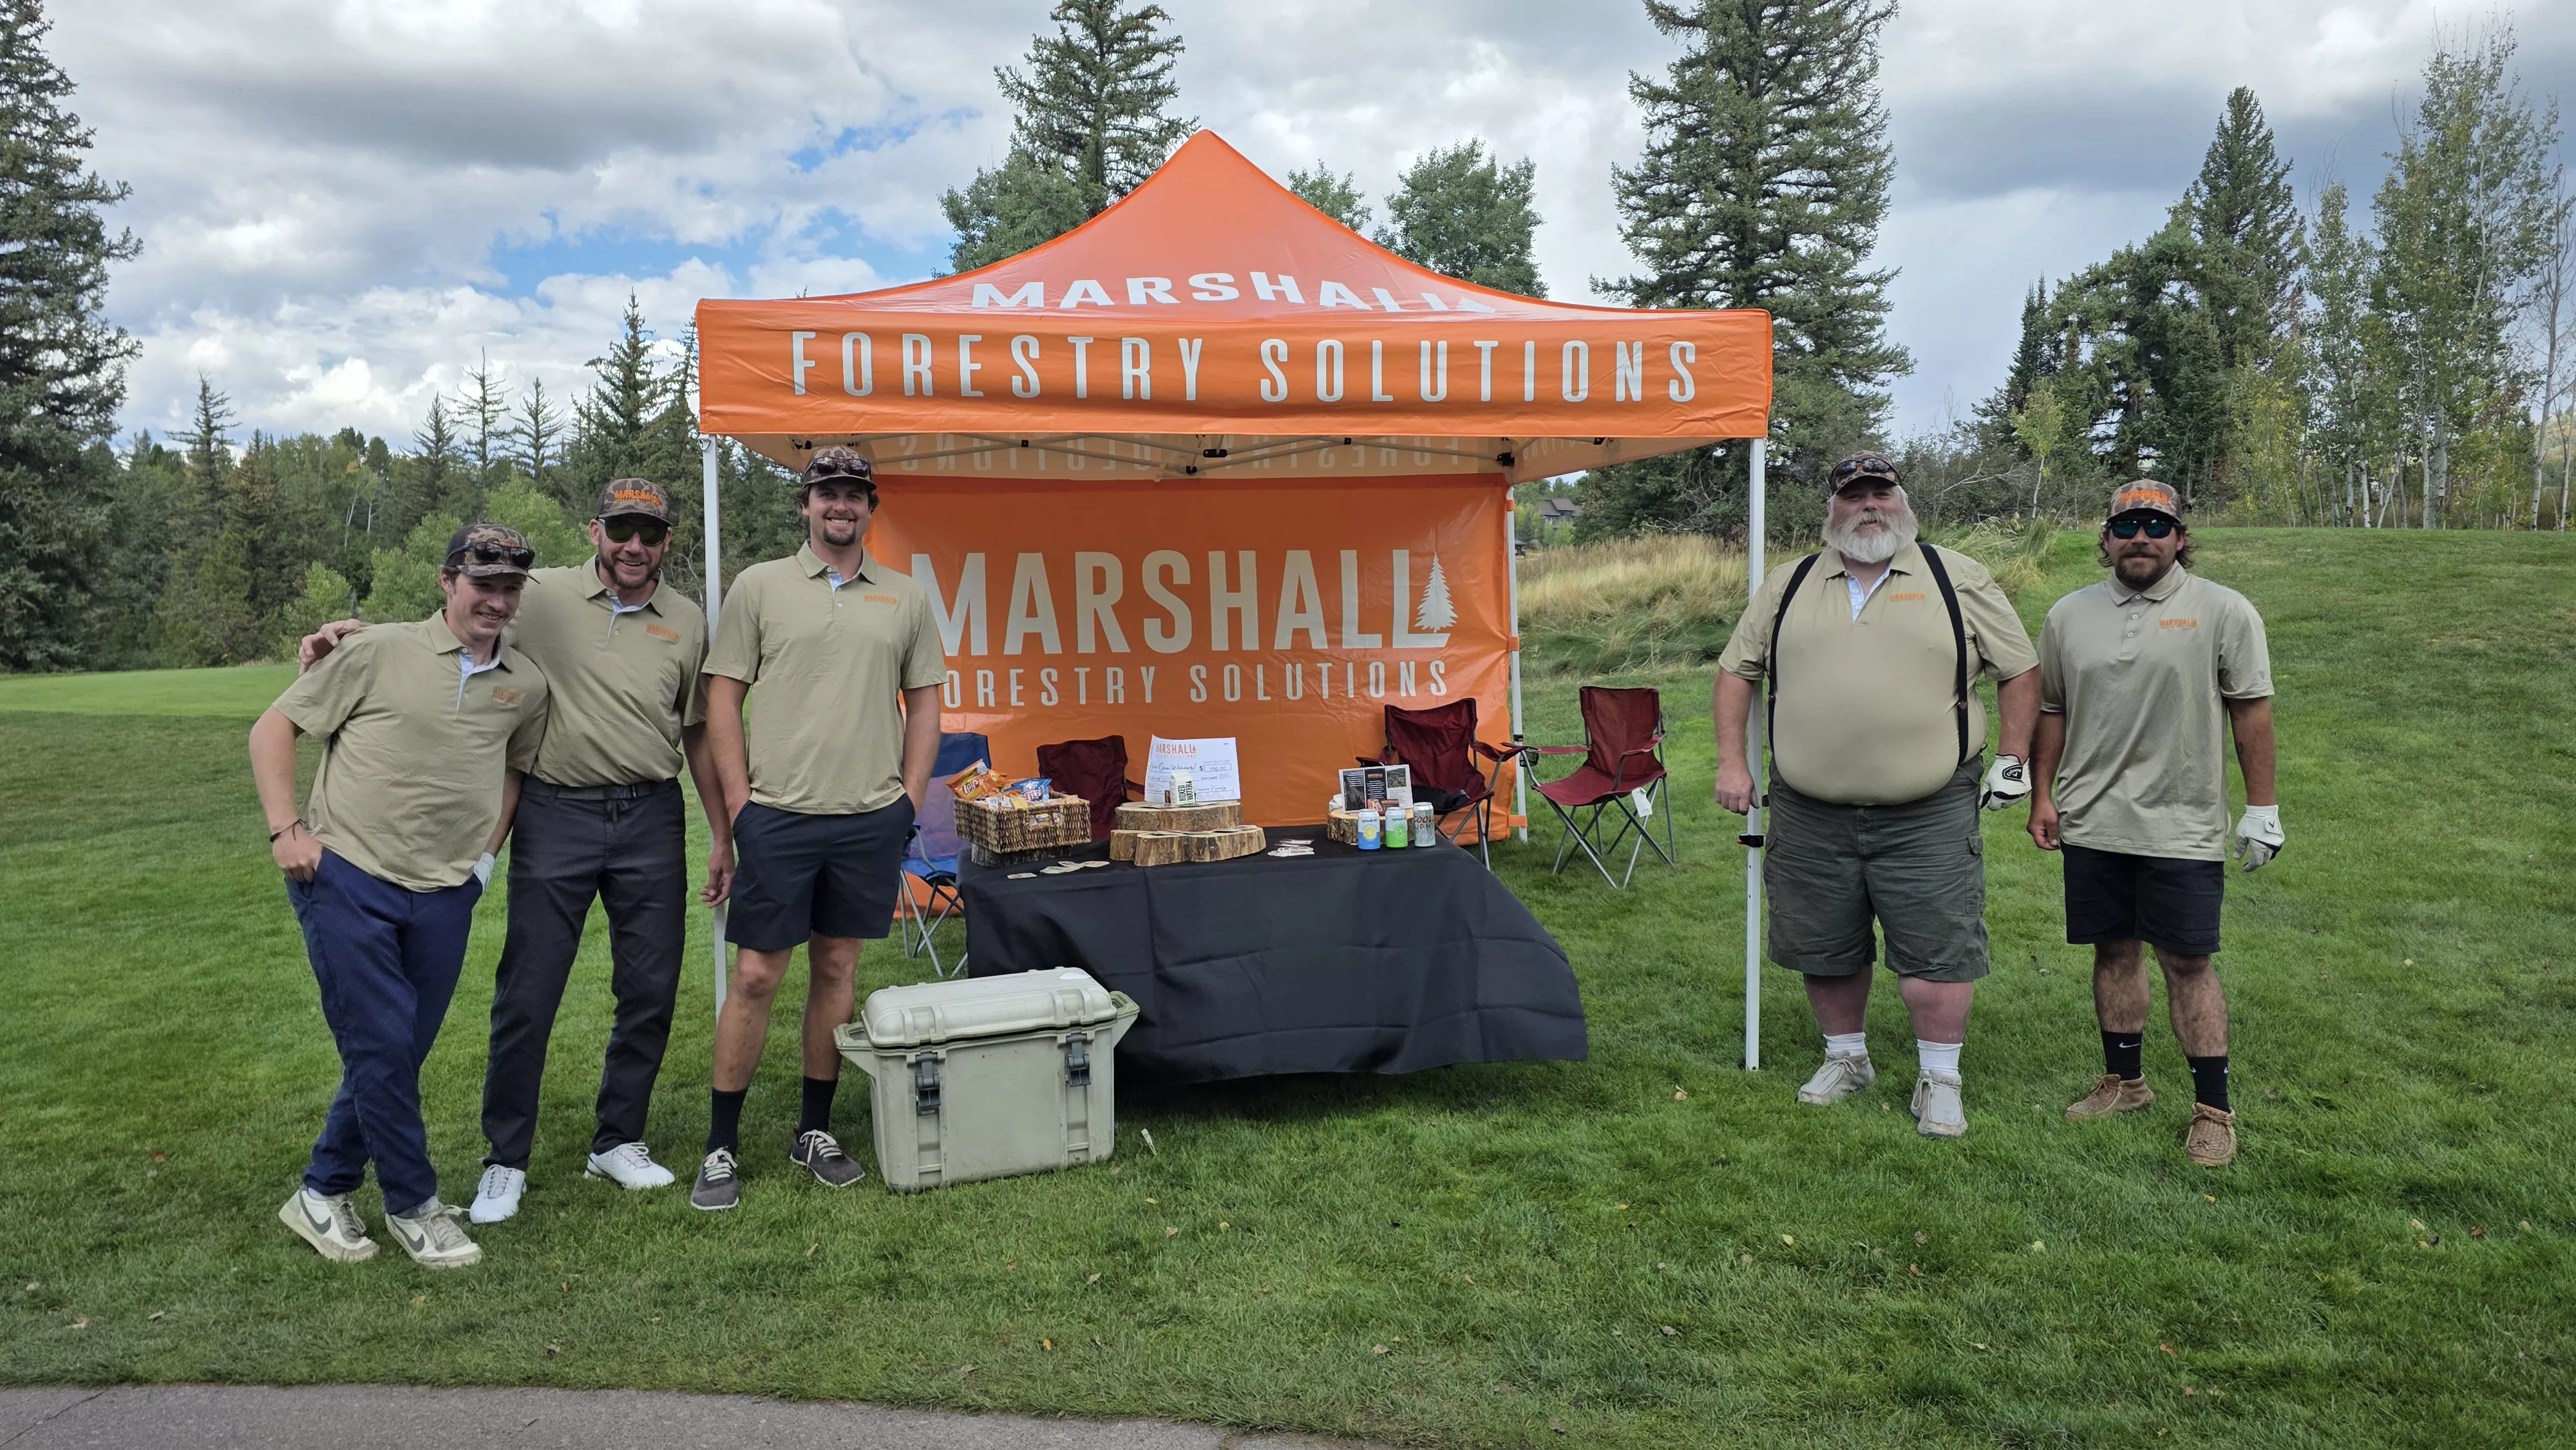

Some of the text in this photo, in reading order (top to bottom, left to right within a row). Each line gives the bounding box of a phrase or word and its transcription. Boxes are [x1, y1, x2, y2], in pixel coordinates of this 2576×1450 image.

[792, 331, 1696, 403] FORESTRY SOLUTIONS
[911, 549, 1448, 657] MARSHALL
[943, 659, 1447, 708] ORESTRY SOLUTIONS
[1178, 785, 1186, 802] BOXED
[1186, 784, 1194, 801] WATER
